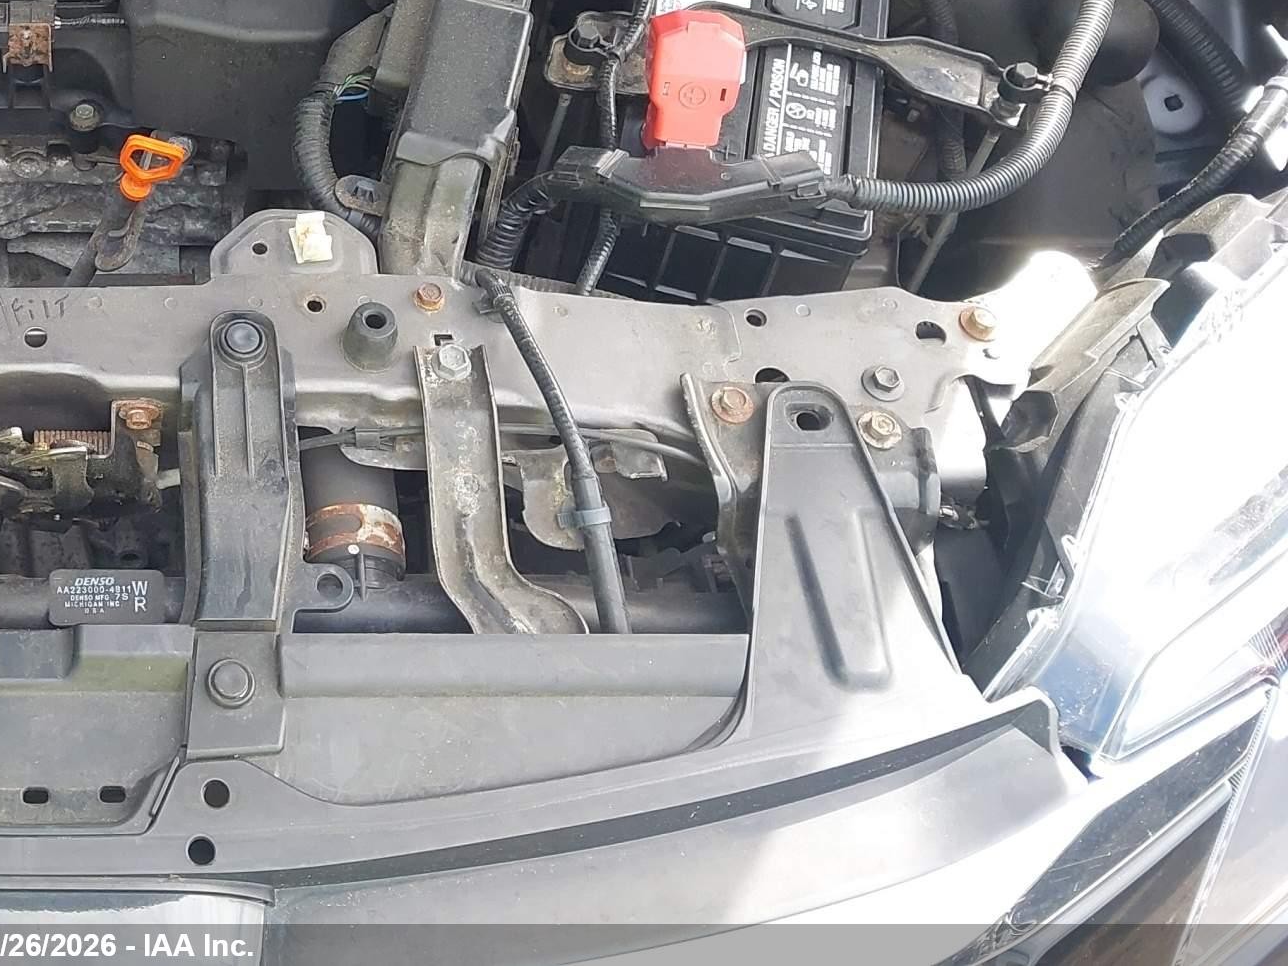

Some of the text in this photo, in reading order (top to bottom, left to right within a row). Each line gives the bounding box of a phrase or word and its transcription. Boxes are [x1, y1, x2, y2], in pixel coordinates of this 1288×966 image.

[769, 58, 786, 98] POISON
[763, 106, 780, 151] DANGER
[74, 577, 115, 586] DENSO
[131, 580, 148, 596] W
[134, 596, 147, 613] R
